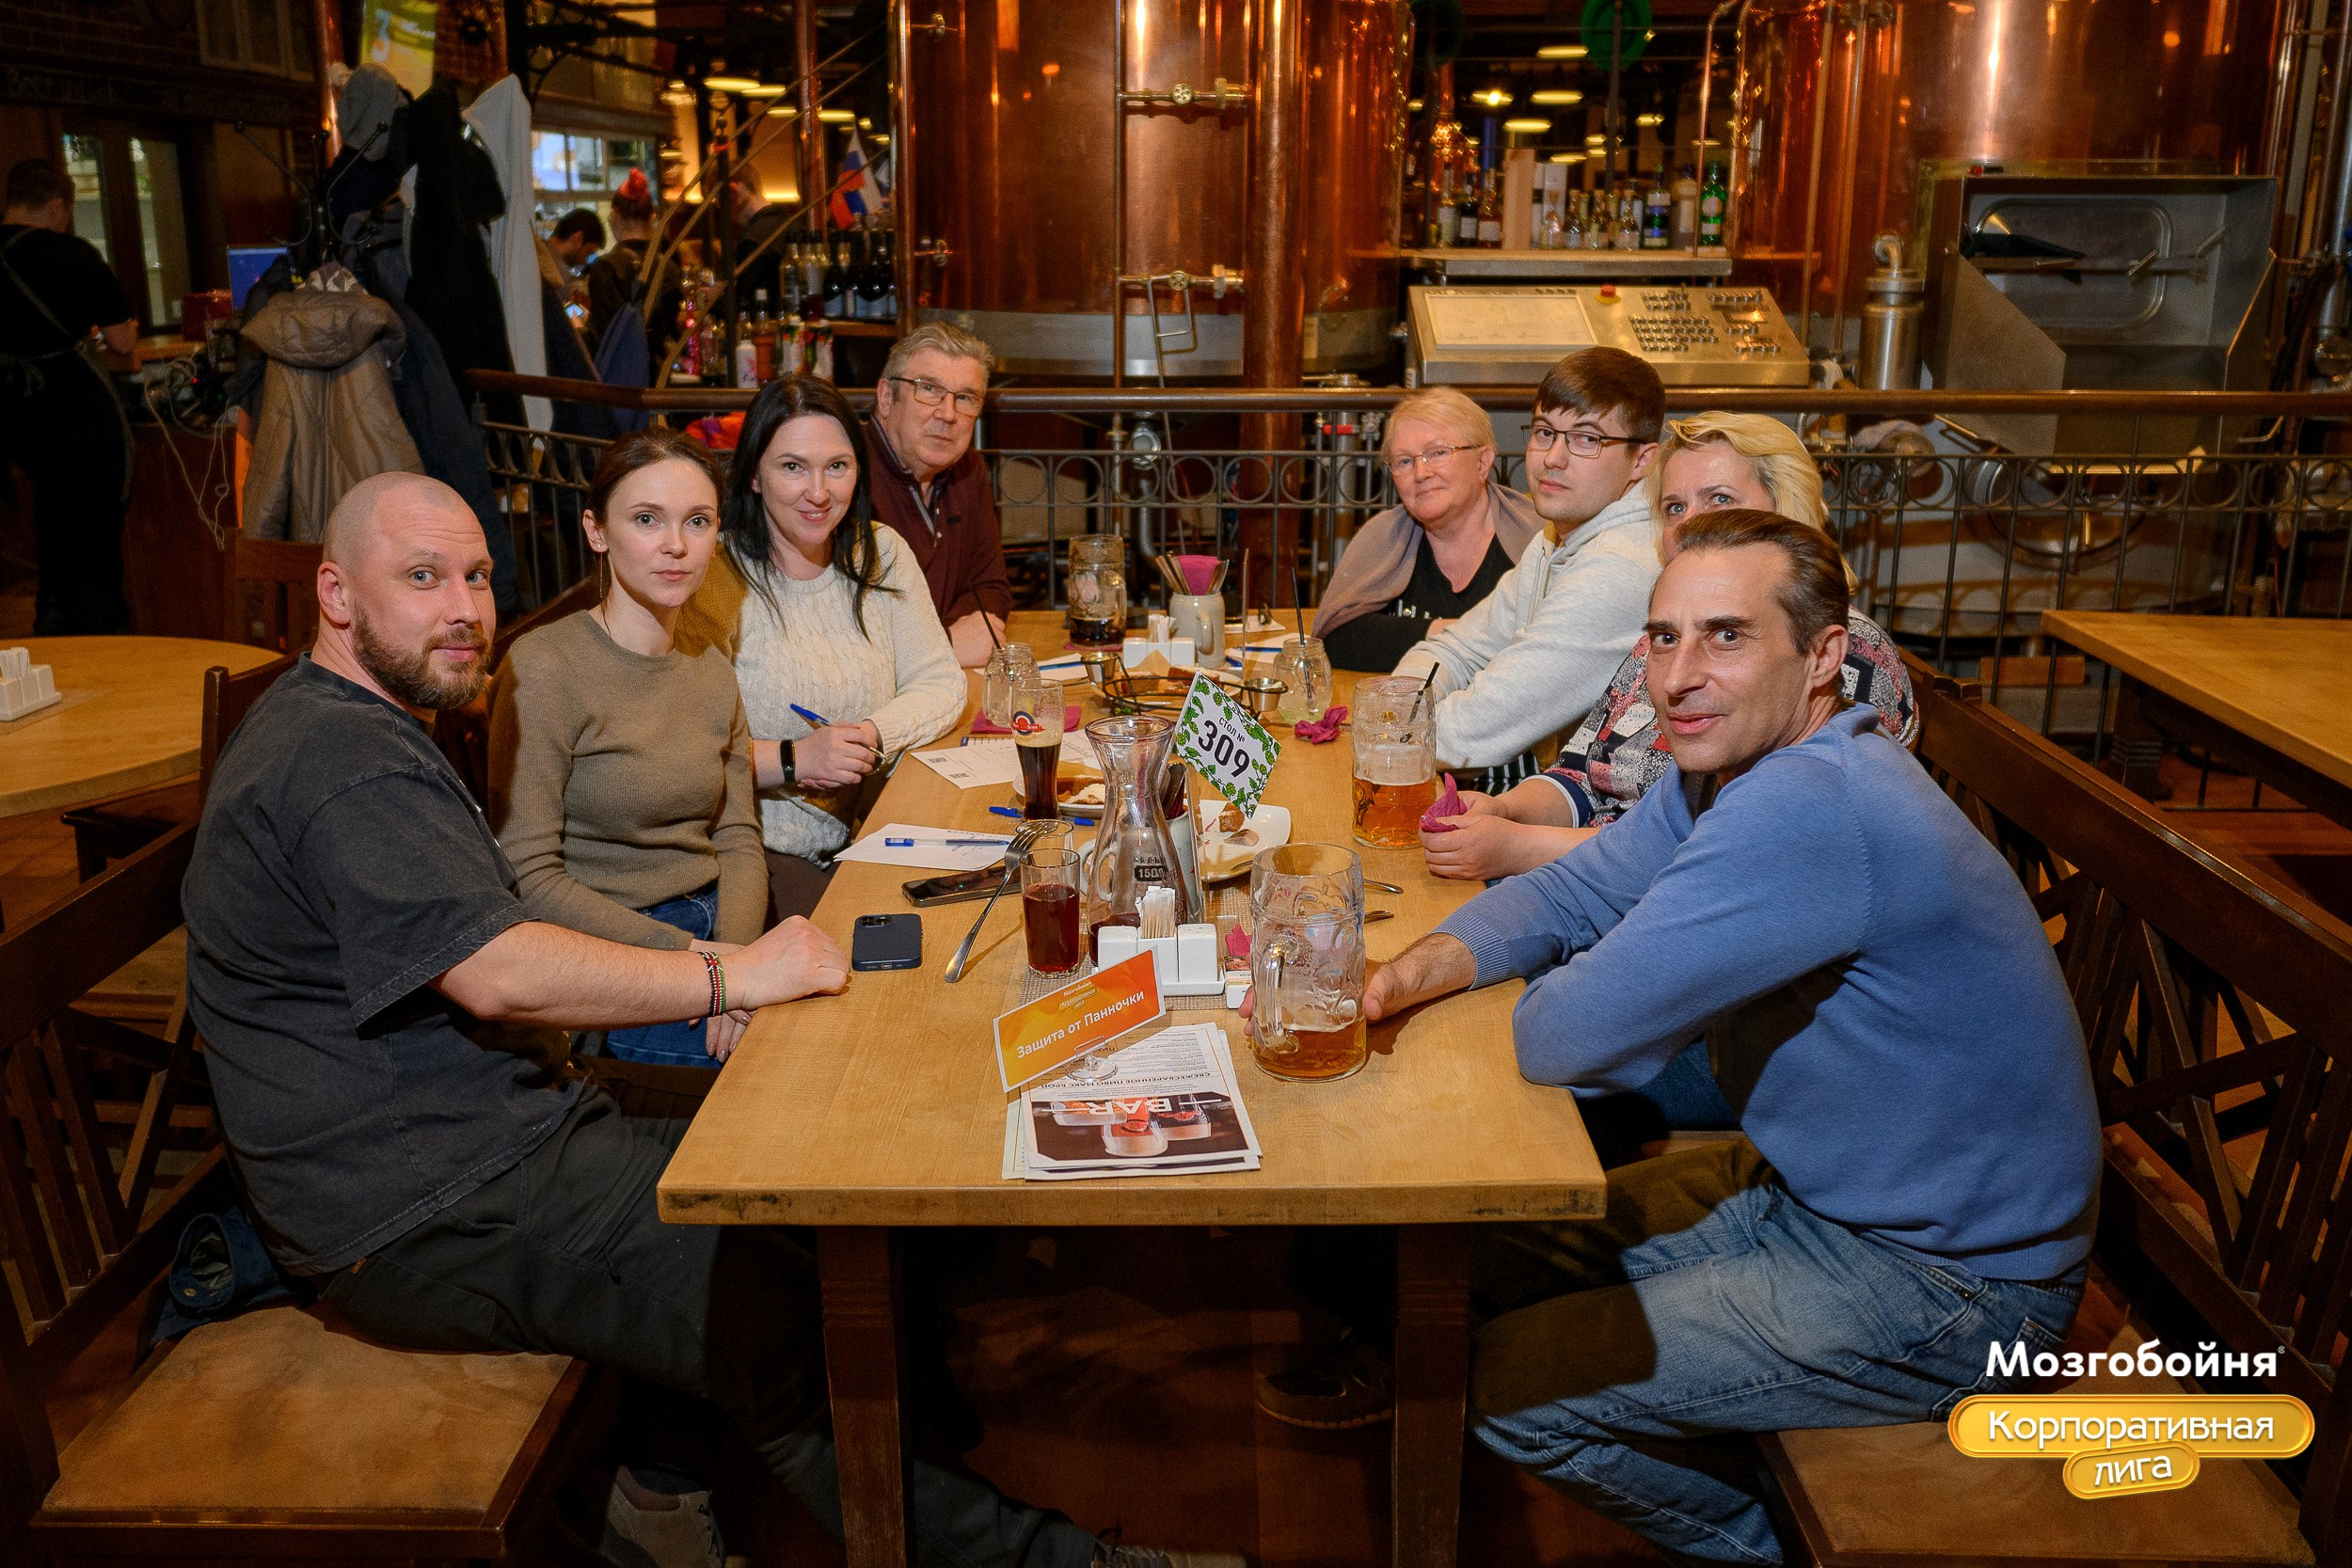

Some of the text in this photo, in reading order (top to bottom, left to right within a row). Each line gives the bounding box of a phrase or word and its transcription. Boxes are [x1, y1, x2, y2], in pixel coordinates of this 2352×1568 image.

[1218, 717, 1237, 736] СТОЛ
[1198, 720, 1249, 778] 309
[1016, 990, 1145, 1059] Защита от Панночки
[1125, 1072, 1211, 1084] СВЕЖЕСВАРЕННОЕ
[1089, 1098, 1172, 1115] BAR
